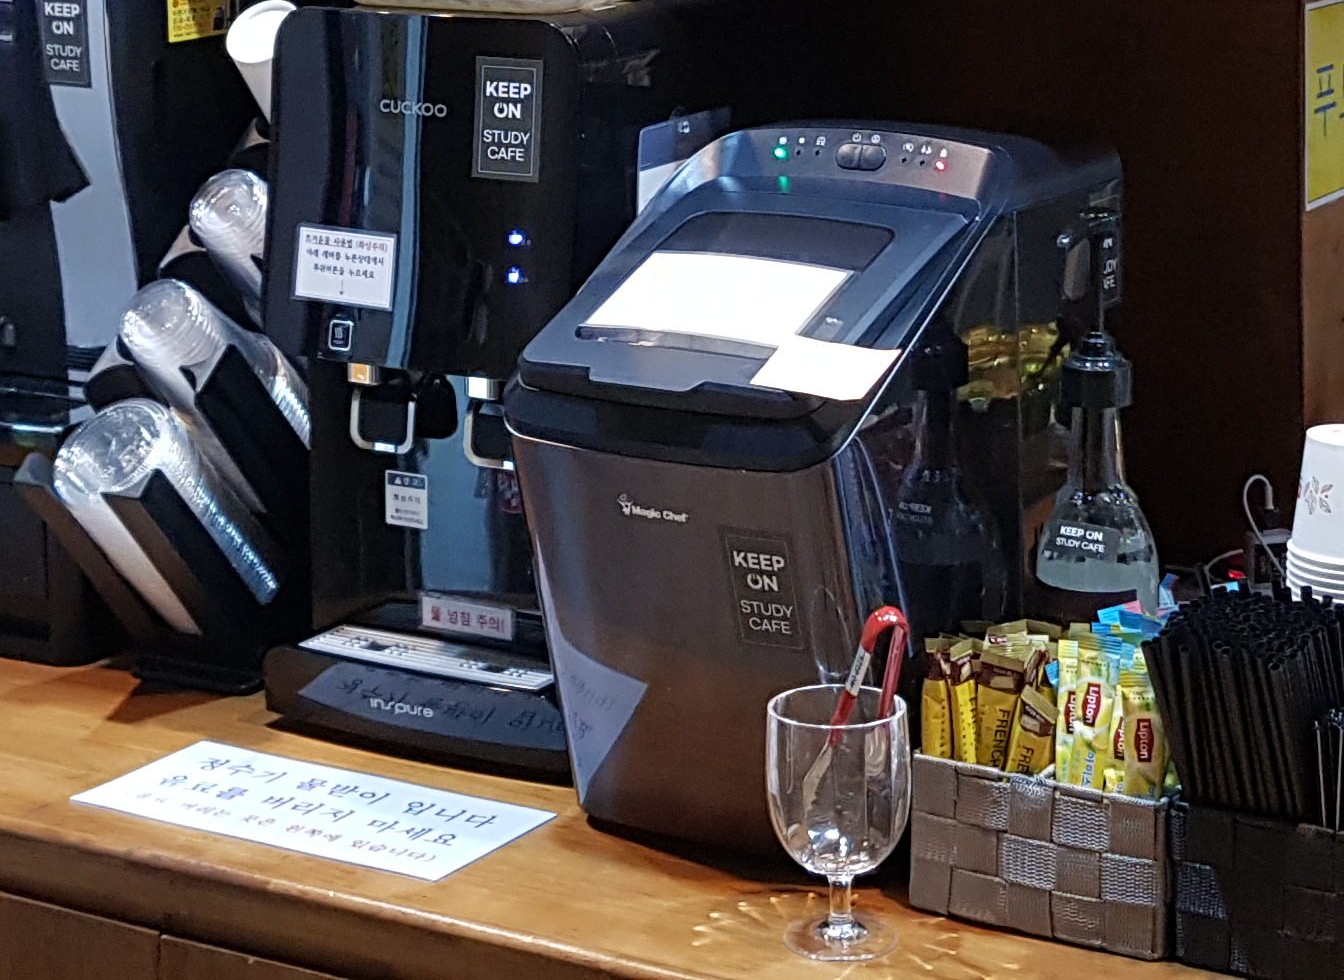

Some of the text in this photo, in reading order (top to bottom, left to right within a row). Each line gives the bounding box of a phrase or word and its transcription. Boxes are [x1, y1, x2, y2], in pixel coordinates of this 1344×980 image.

[44, 1, 80, 17] KEEP
[52, 21, 74, 35] ON
[45, 44, 82, 58] STUDY
[50, 59, 81, 71] CAFE
[485, 81, 532, 99] KEEP
[379, 99, 448, 117] CUCKOO
[493, 102, 522, 119] ON
[483, 129, 530, 145] STUDY
[487, 146, 525, 162] CAFE
[631, 505, 688, 522] Magic Chef
[1059, 525, 1103, 541] KEEP ON
[1056, 537, 1105, 553] STUDY CAFE
[732, 550, 785, 572] KEEP
[746, 573, 780, 592] ON
[740, 599, 793, 618] STUDY
[447, 609, 470, 627] 넘침
[749, 617, 792, 634] CAFE
[1084, 685, 1100, 724] Lipton
[1138, 721, 1150, 760] Lipton
[199, 757, 288, 784] 정수기
[402, 800, 498, 828] 입니다
[260, 795, 356, 823] 버리지
[367, 819, 457, 846] 마세요
